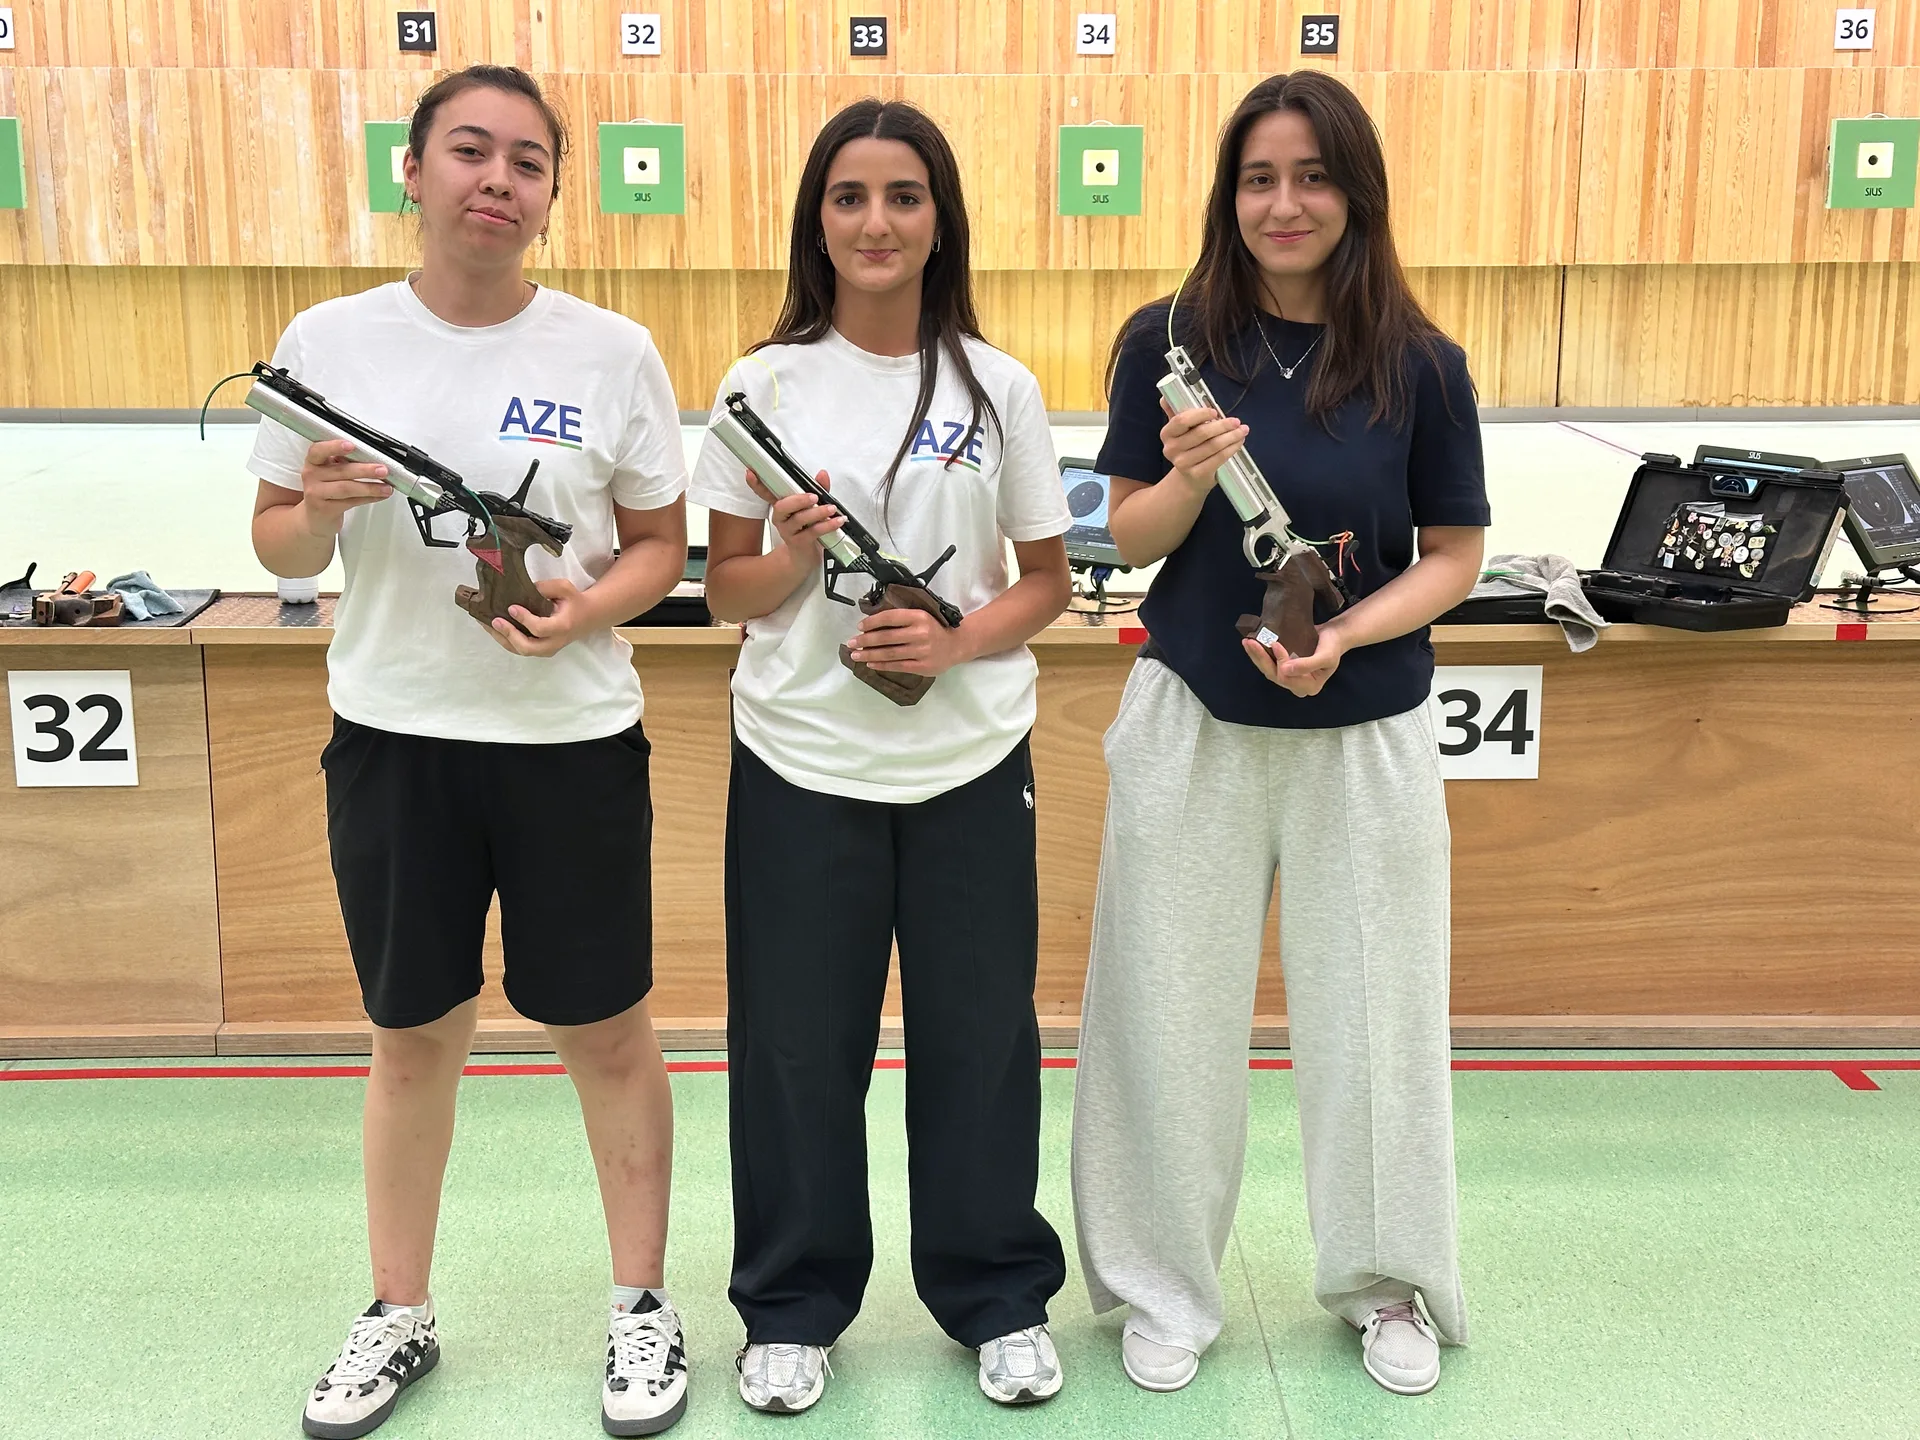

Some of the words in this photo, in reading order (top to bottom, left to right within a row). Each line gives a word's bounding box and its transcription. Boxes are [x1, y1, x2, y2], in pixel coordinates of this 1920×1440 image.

[403, 19, 432, 43] 31
[627, 24, 655, 45] 32
[853, 24, 884, 48] 33
[1082, 24, 1110, 45] 34
[1304, 23, 1335, 46] 35
[1840, 19, 1869, 40] 36
[634, 193, 652, 202] SIUS
[1092, 194, 1109, 204] SIUS
[1865, 187, 1882, 197] SIUS
[500, 396, 582, 443] AZE
[911, 419, 985, 465] AZE
[24, 693, 129, 763] 32
[1437, 688, 1534, 756] 34
